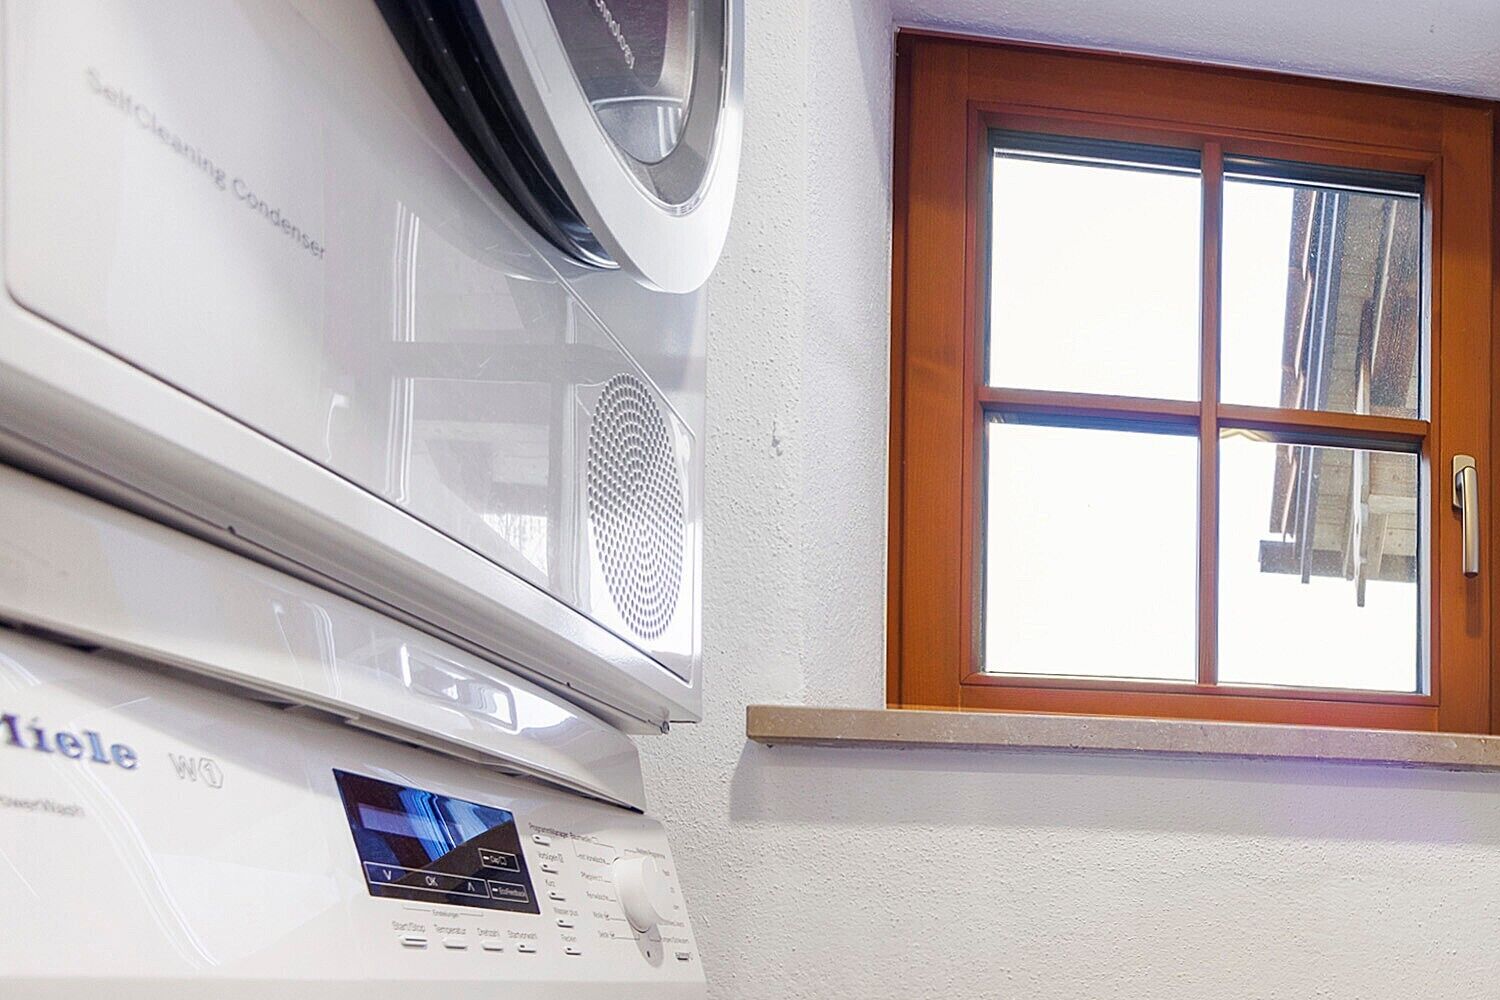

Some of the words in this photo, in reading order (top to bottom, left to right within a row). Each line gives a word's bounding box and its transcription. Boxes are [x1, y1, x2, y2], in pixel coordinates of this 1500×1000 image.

[86, 66, 227, 191] SelfCleaning
[232, 178, 326, 259] Condenser
[425, 875, 439, 887] OK
